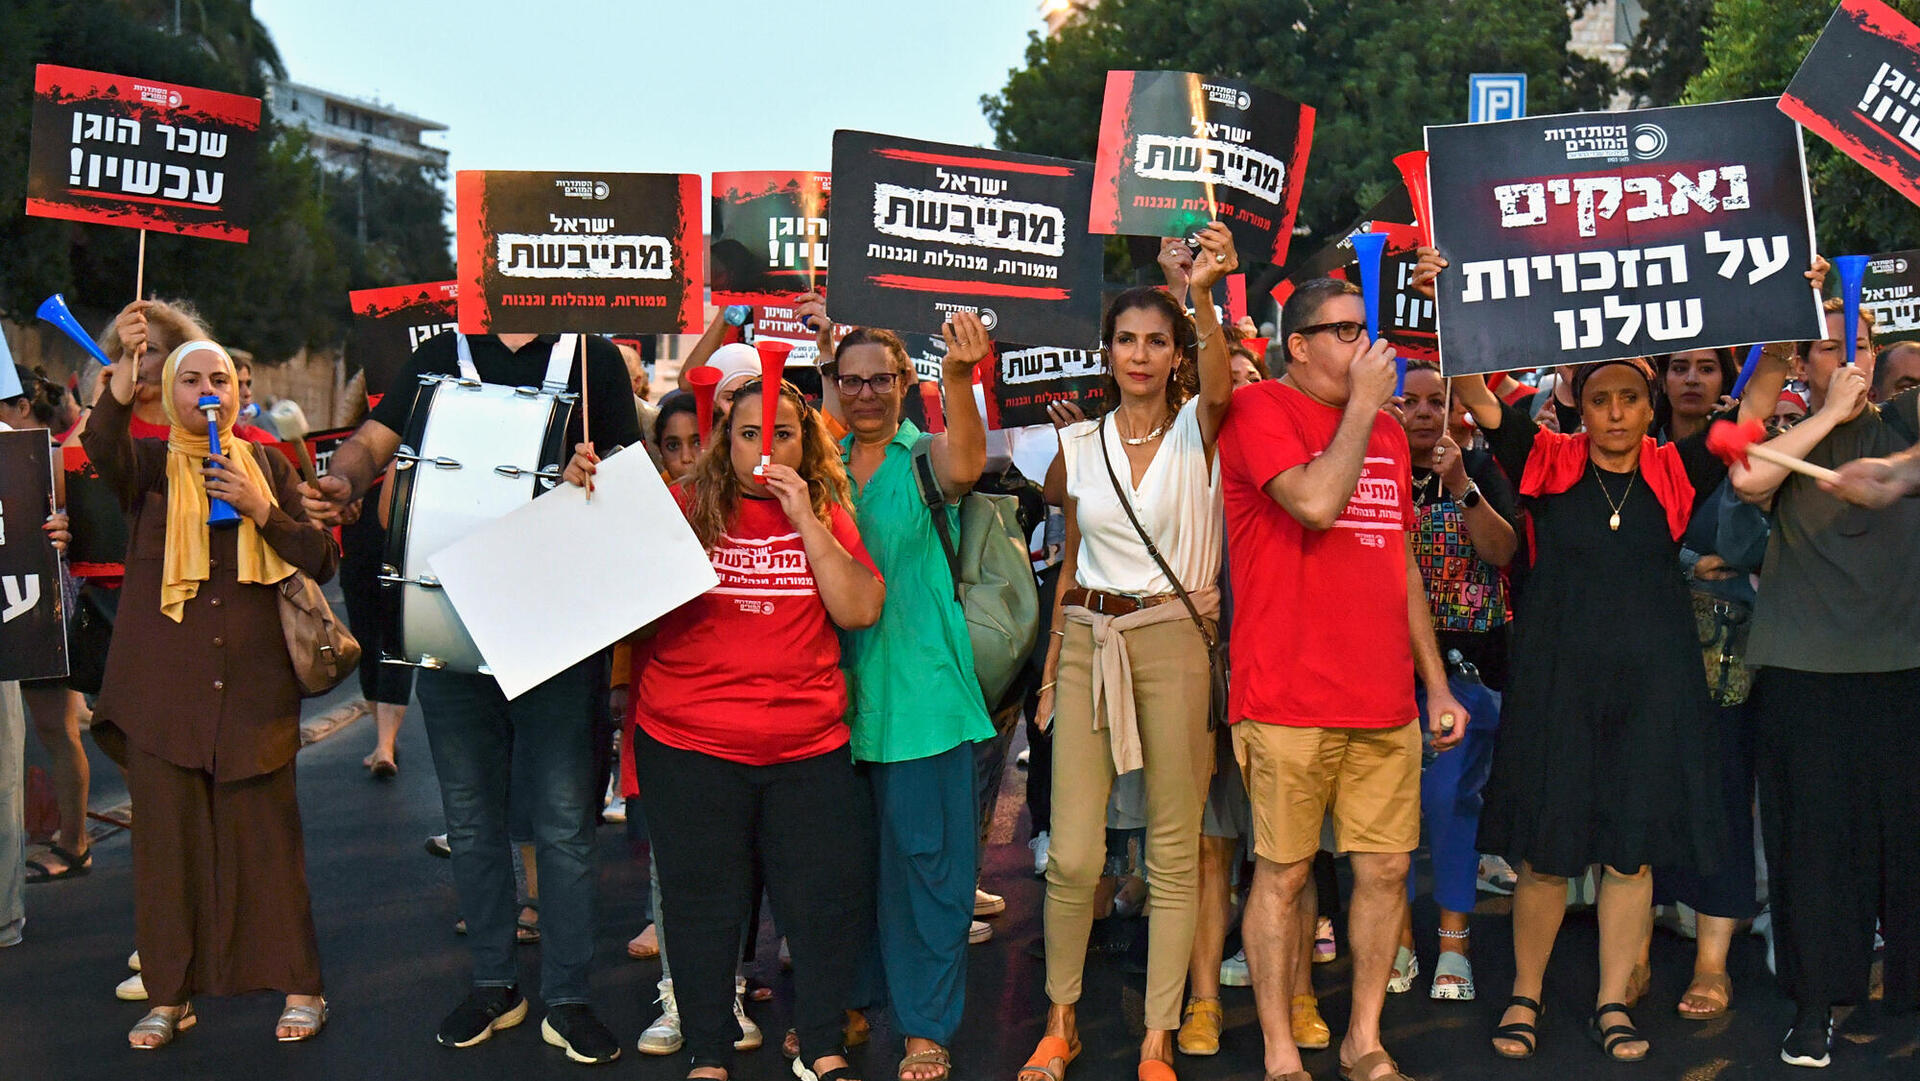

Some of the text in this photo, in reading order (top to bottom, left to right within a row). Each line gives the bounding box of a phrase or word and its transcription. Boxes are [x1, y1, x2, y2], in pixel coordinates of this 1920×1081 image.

[1200, 83, 1237, 96] הסתדרות
[71, 111, 228, 158] שכר הוגן
[1190, 116, 1252, 143] ישראל
[1544, 125, 1627, 142] הסתדרות
[1565, 137, 1628, 152] המורים
[69, 147, 225, 205] עכשיו!
[935, 167, 1008, 196] ישראל
[1143, 144, 1280, 195] מתייבשת
[1132, 194, 1176, 210] וגננות
[1181, 197, 1235, 217] מנלות
[1493, 164, 1751, 238] נאבקים
[550, 213, 615, 233] ישראל
[769, 216, 828, 241] הוגן
[884, 196, 1056, 246] מתייבשת
[507, 242, 664, 270] מתייבשת
[866, 242, 1058, 280] ממורות, מנהלות וגננות
[1703, 229, 1791, 286] על
[1461, 244, 1689, 303] הזכויות
[501, 291, 668, 308] ממורות, מנהלות וגננות
[1861, 285, 1913, 302] ישראל
[1553, 295, 1703, 351] שלנו
[1007, 349, 1102, 379] תייבשת
[1359, 483, 1396, 501] מתיי
